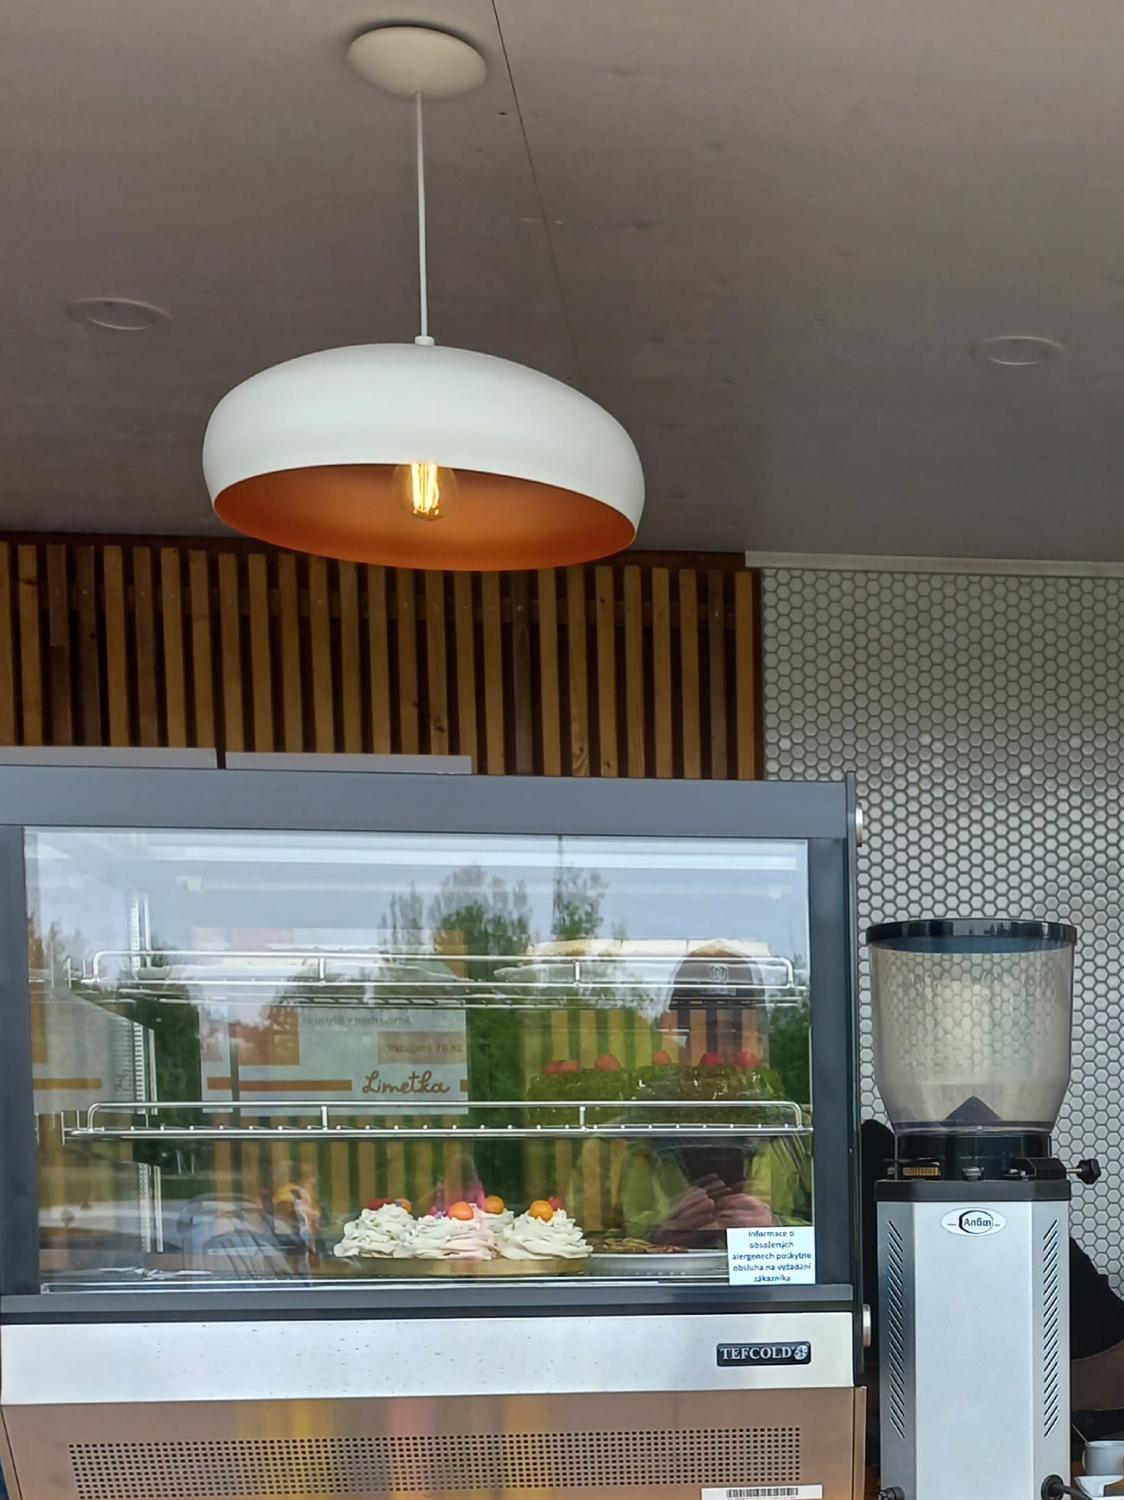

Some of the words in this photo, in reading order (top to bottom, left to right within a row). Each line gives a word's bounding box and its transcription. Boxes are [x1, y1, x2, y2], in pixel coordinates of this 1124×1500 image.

[361, 1070, 451, 1095] Limetka
[732, 1263, 764, 1271] obsluha
[719, 1346, 792, 1360] TEFCOLD
